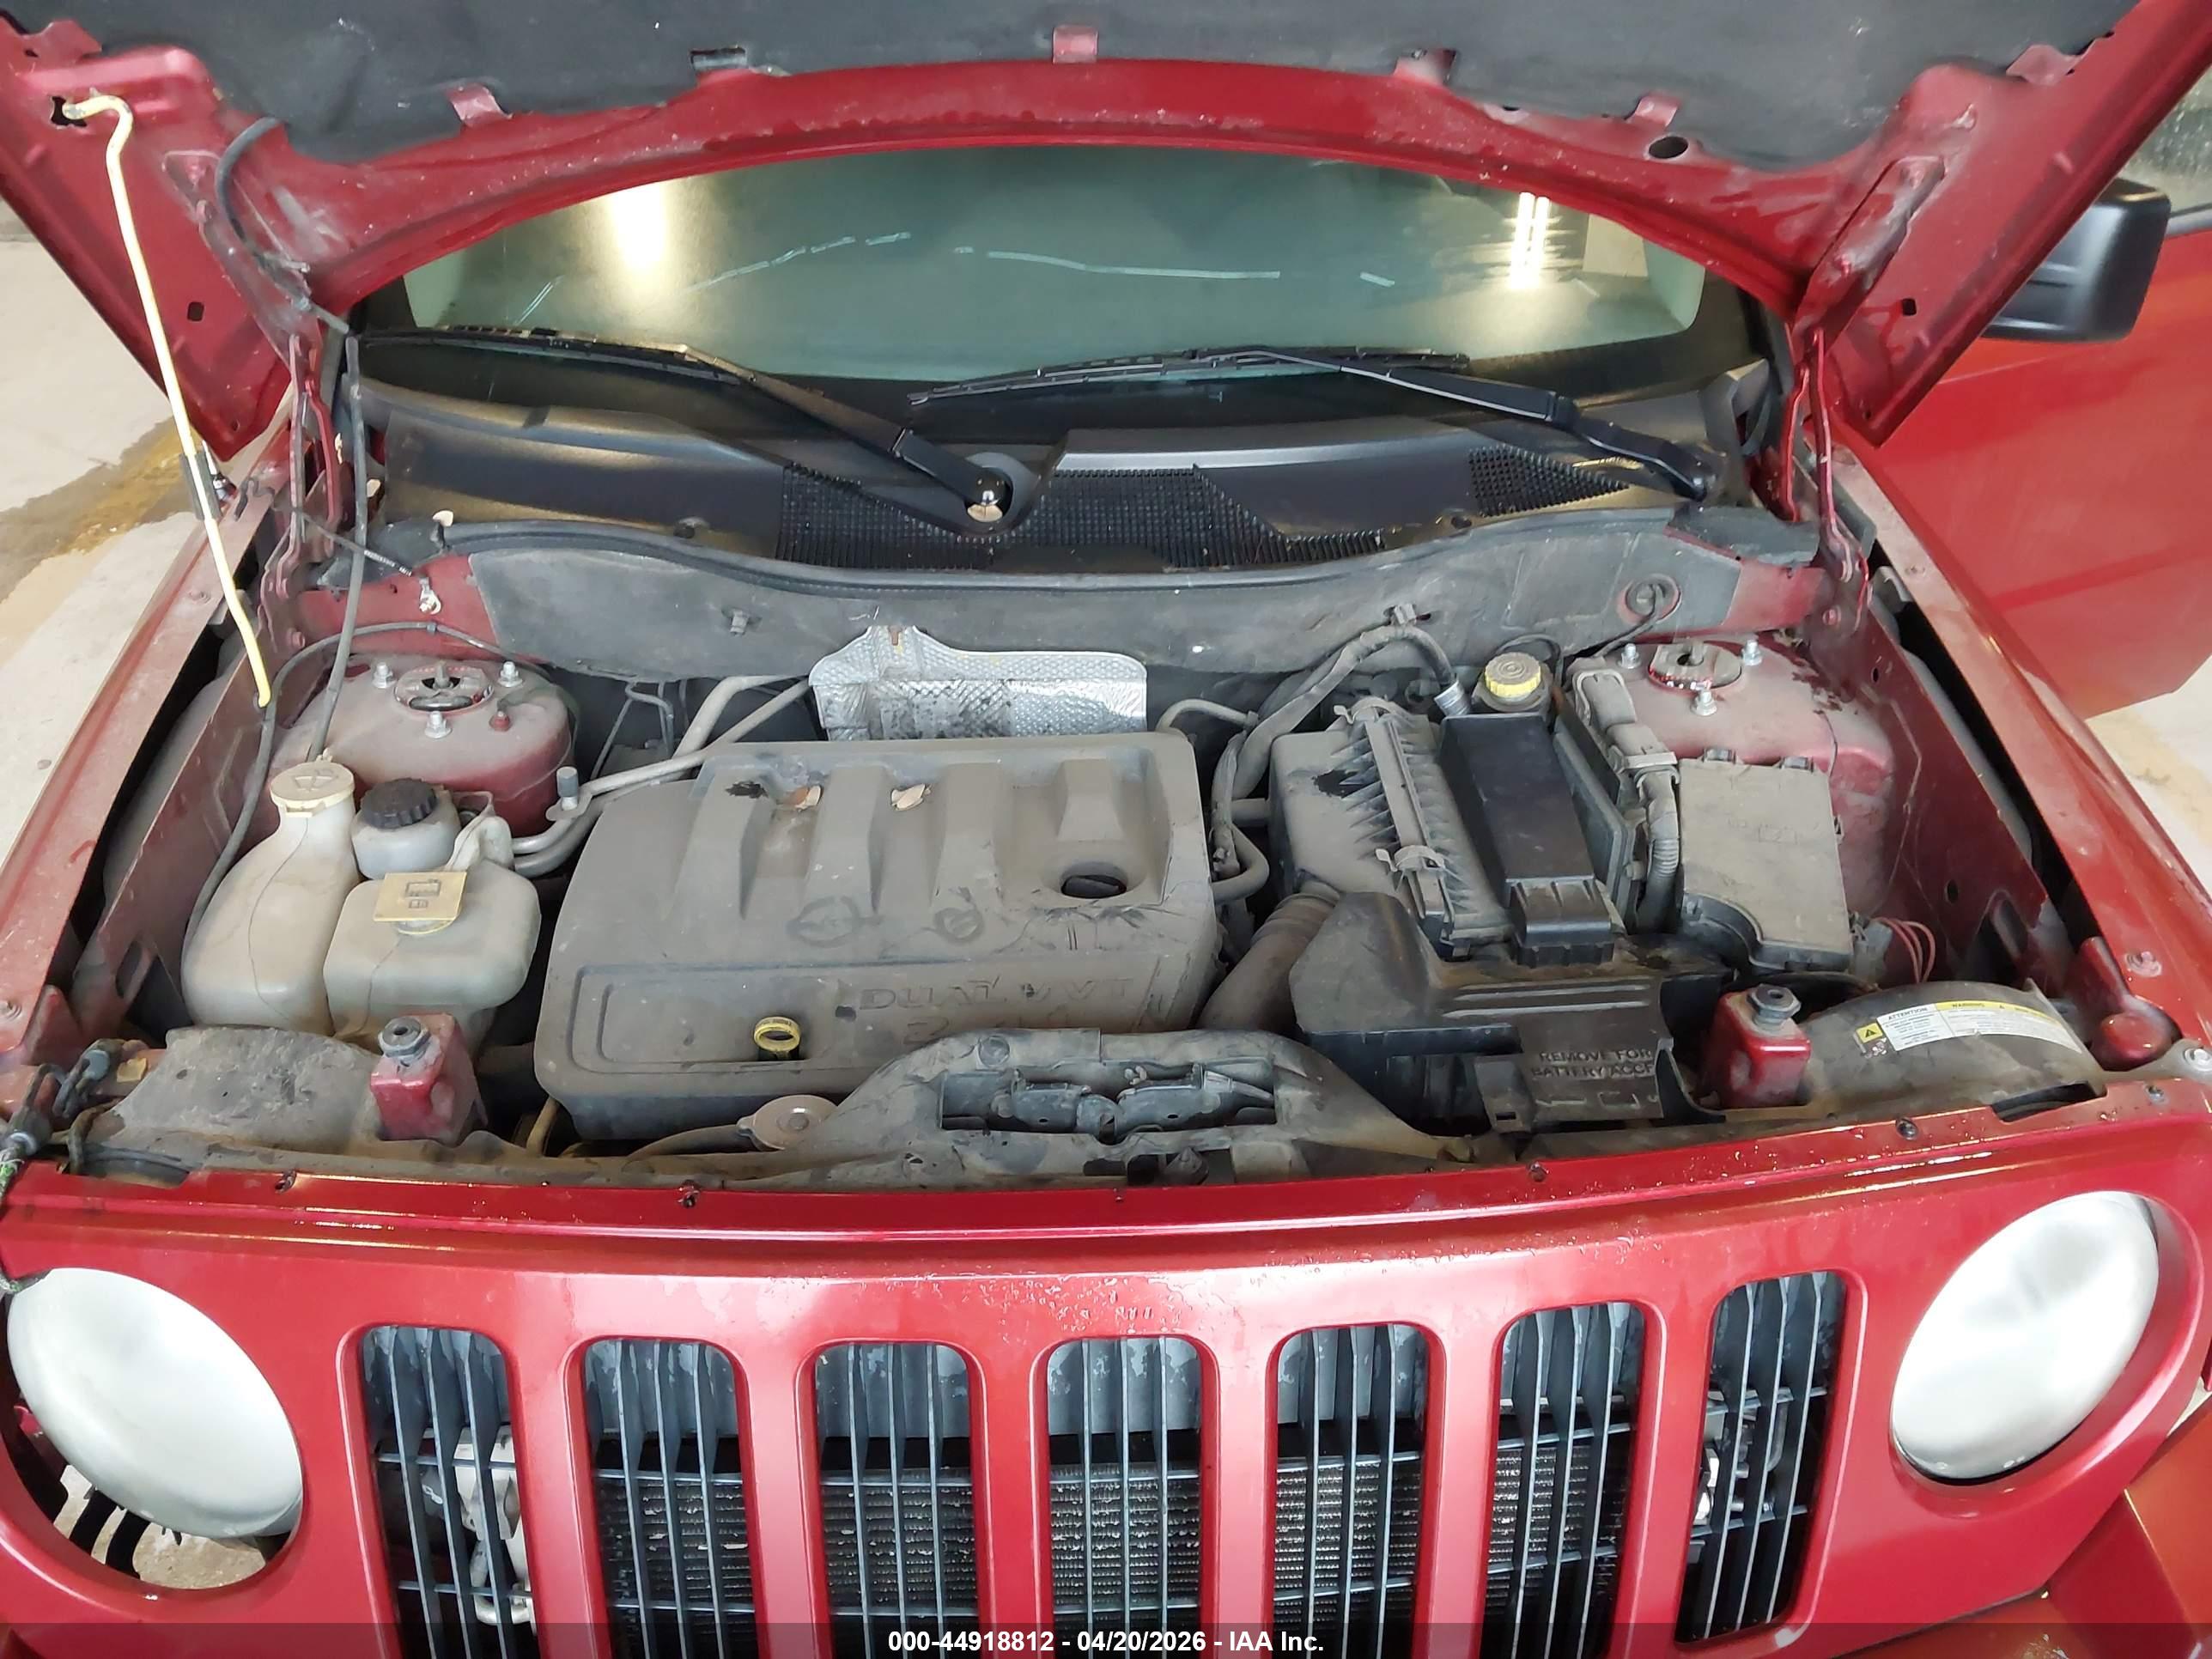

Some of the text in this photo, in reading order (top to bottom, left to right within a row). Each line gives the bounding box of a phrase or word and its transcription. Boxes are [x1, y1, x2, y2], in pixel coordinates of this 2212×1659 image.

[1888, 1006, 1929, 1021] ATTENTION
[1539, 1048, 1653, 1062] REMOVE FOR
[1532, 1065, 1604, 1079] BATTERY
